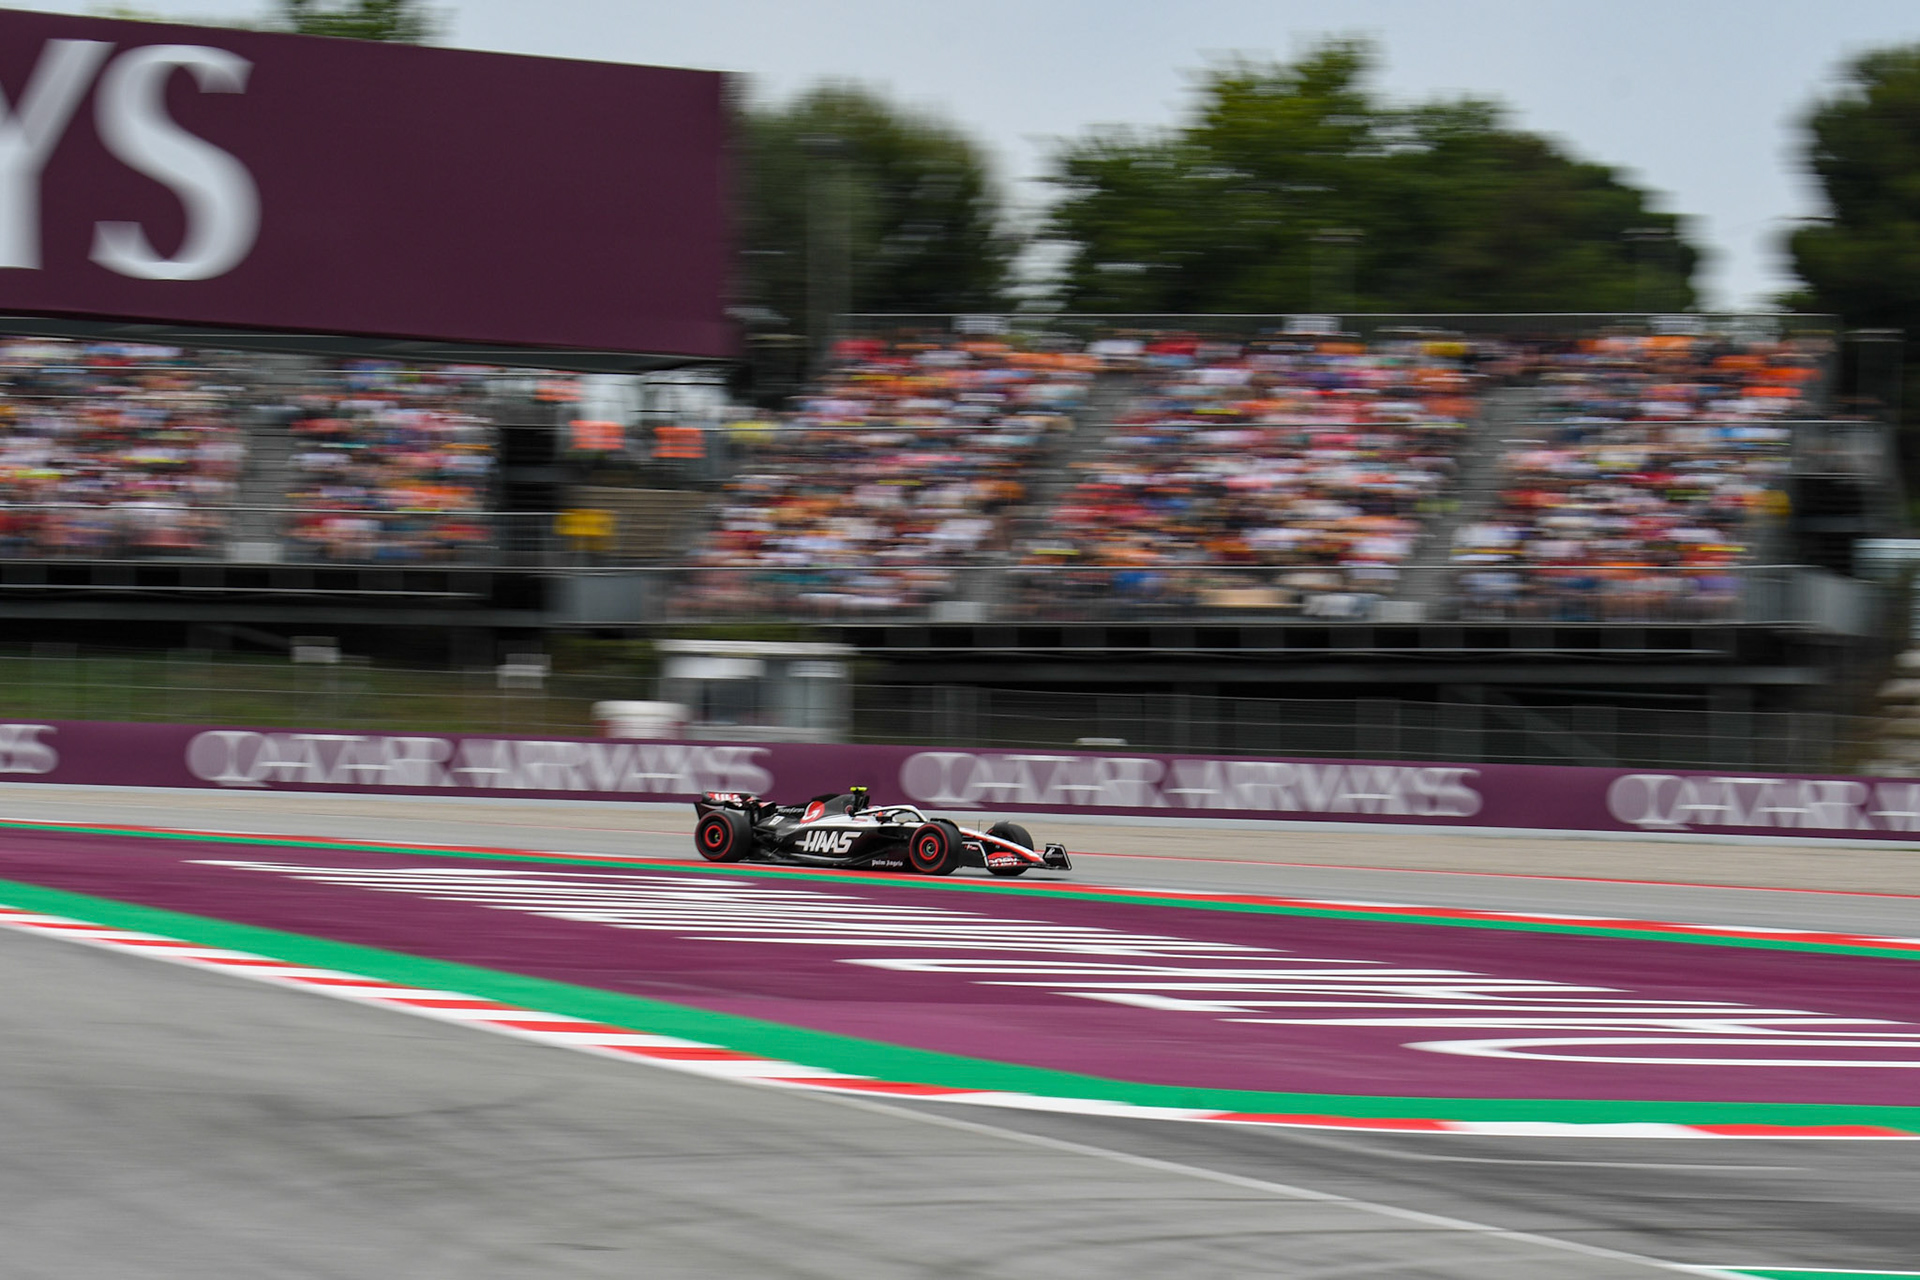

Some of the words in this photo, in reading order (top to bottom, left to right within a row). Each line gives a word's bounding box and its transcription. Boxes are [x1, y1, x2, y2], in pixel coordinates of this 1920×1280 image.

[0, 38, 262, 280] YS
[186, 730, 459, 787] QATAR
[452, 739, 773, 796] AIRWAYS
[901, 751, 1172, 808] QATAR
[1163, 759, 1482, 816] AIRWAYS
[1606, 774, 1878, 831] QATAR
[794, 830, 862, 854] HAAS
